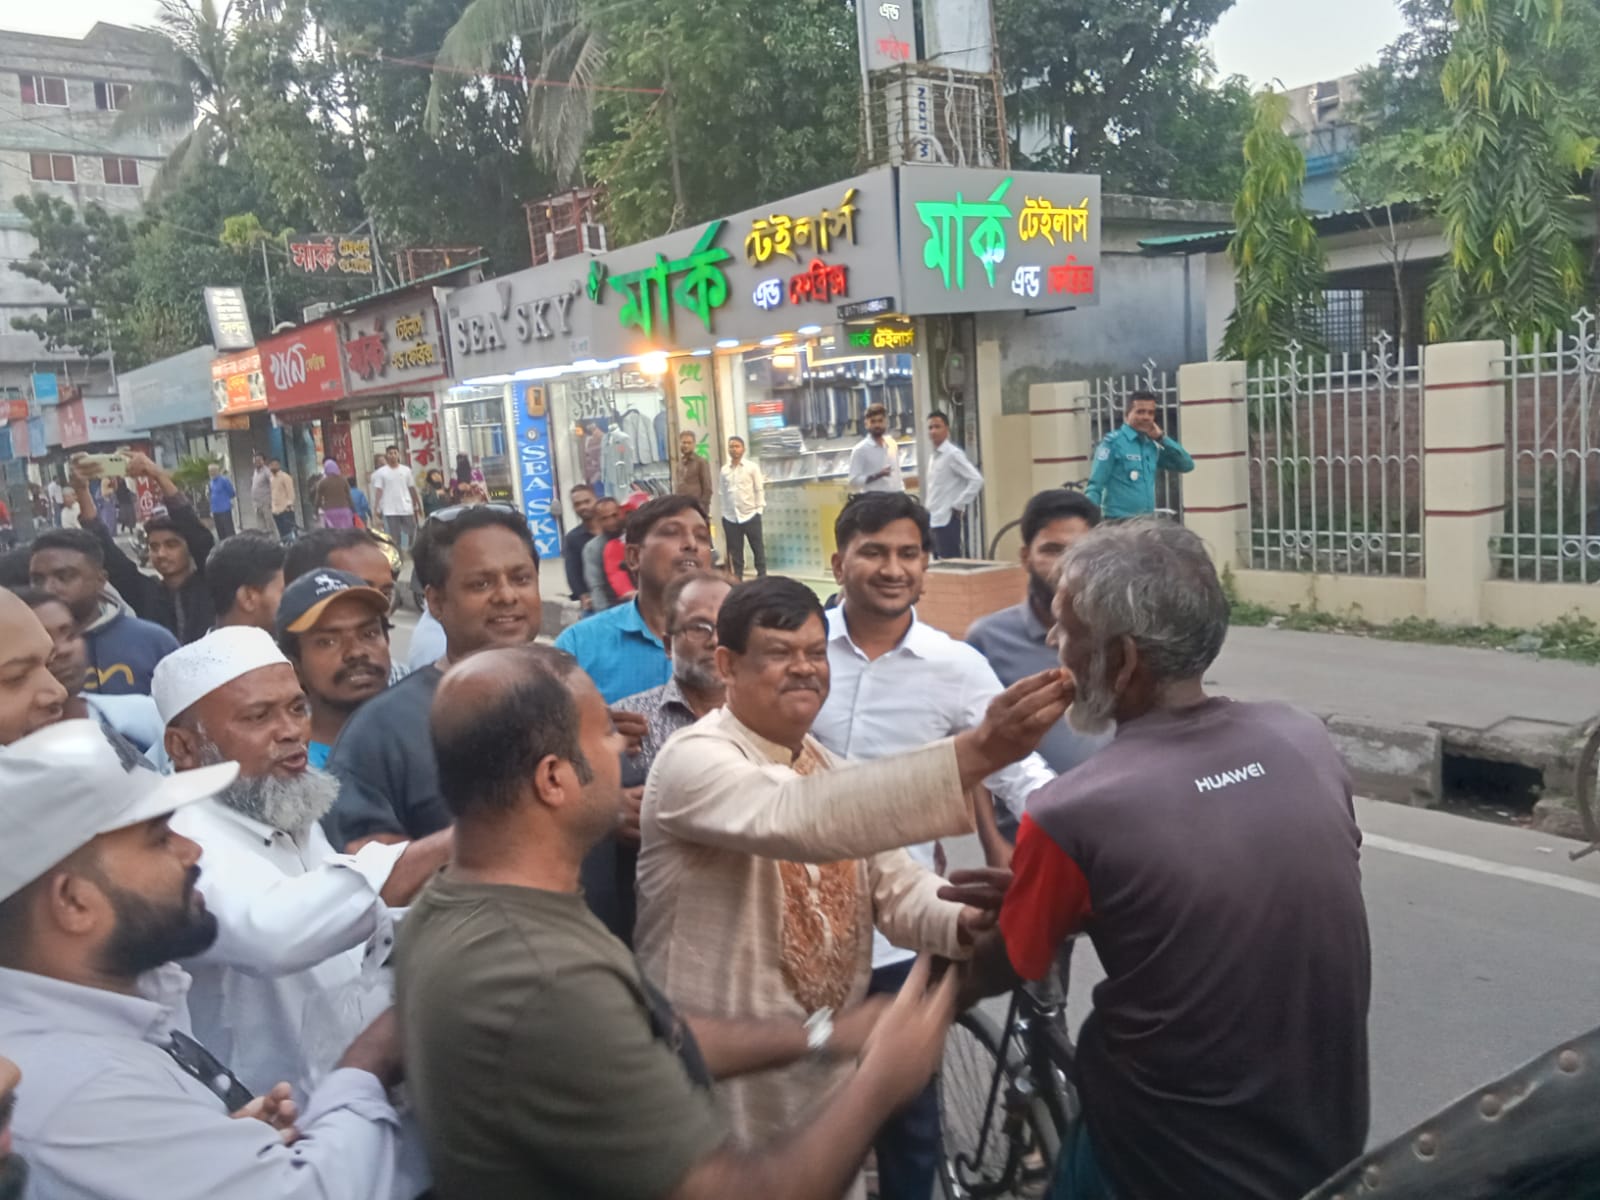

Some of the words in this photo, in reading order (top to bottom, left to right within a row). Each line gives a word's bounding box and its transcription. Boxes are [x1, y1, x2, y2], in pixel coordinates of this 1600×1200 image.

[917, 86, 929, 158] WLTON
[744, 187, 858, 267] টেইলার্স
[1018, 195, 1089, 247] টেইলার্স
[1011, 265, 1041, 297] এন্ড
[515, 292, 573, 343] SKY
[521, 443, 550, 493] SEA
[527, 498, 557, 556] SKY
[1195, 761, 1266, 793] HUAWEI
